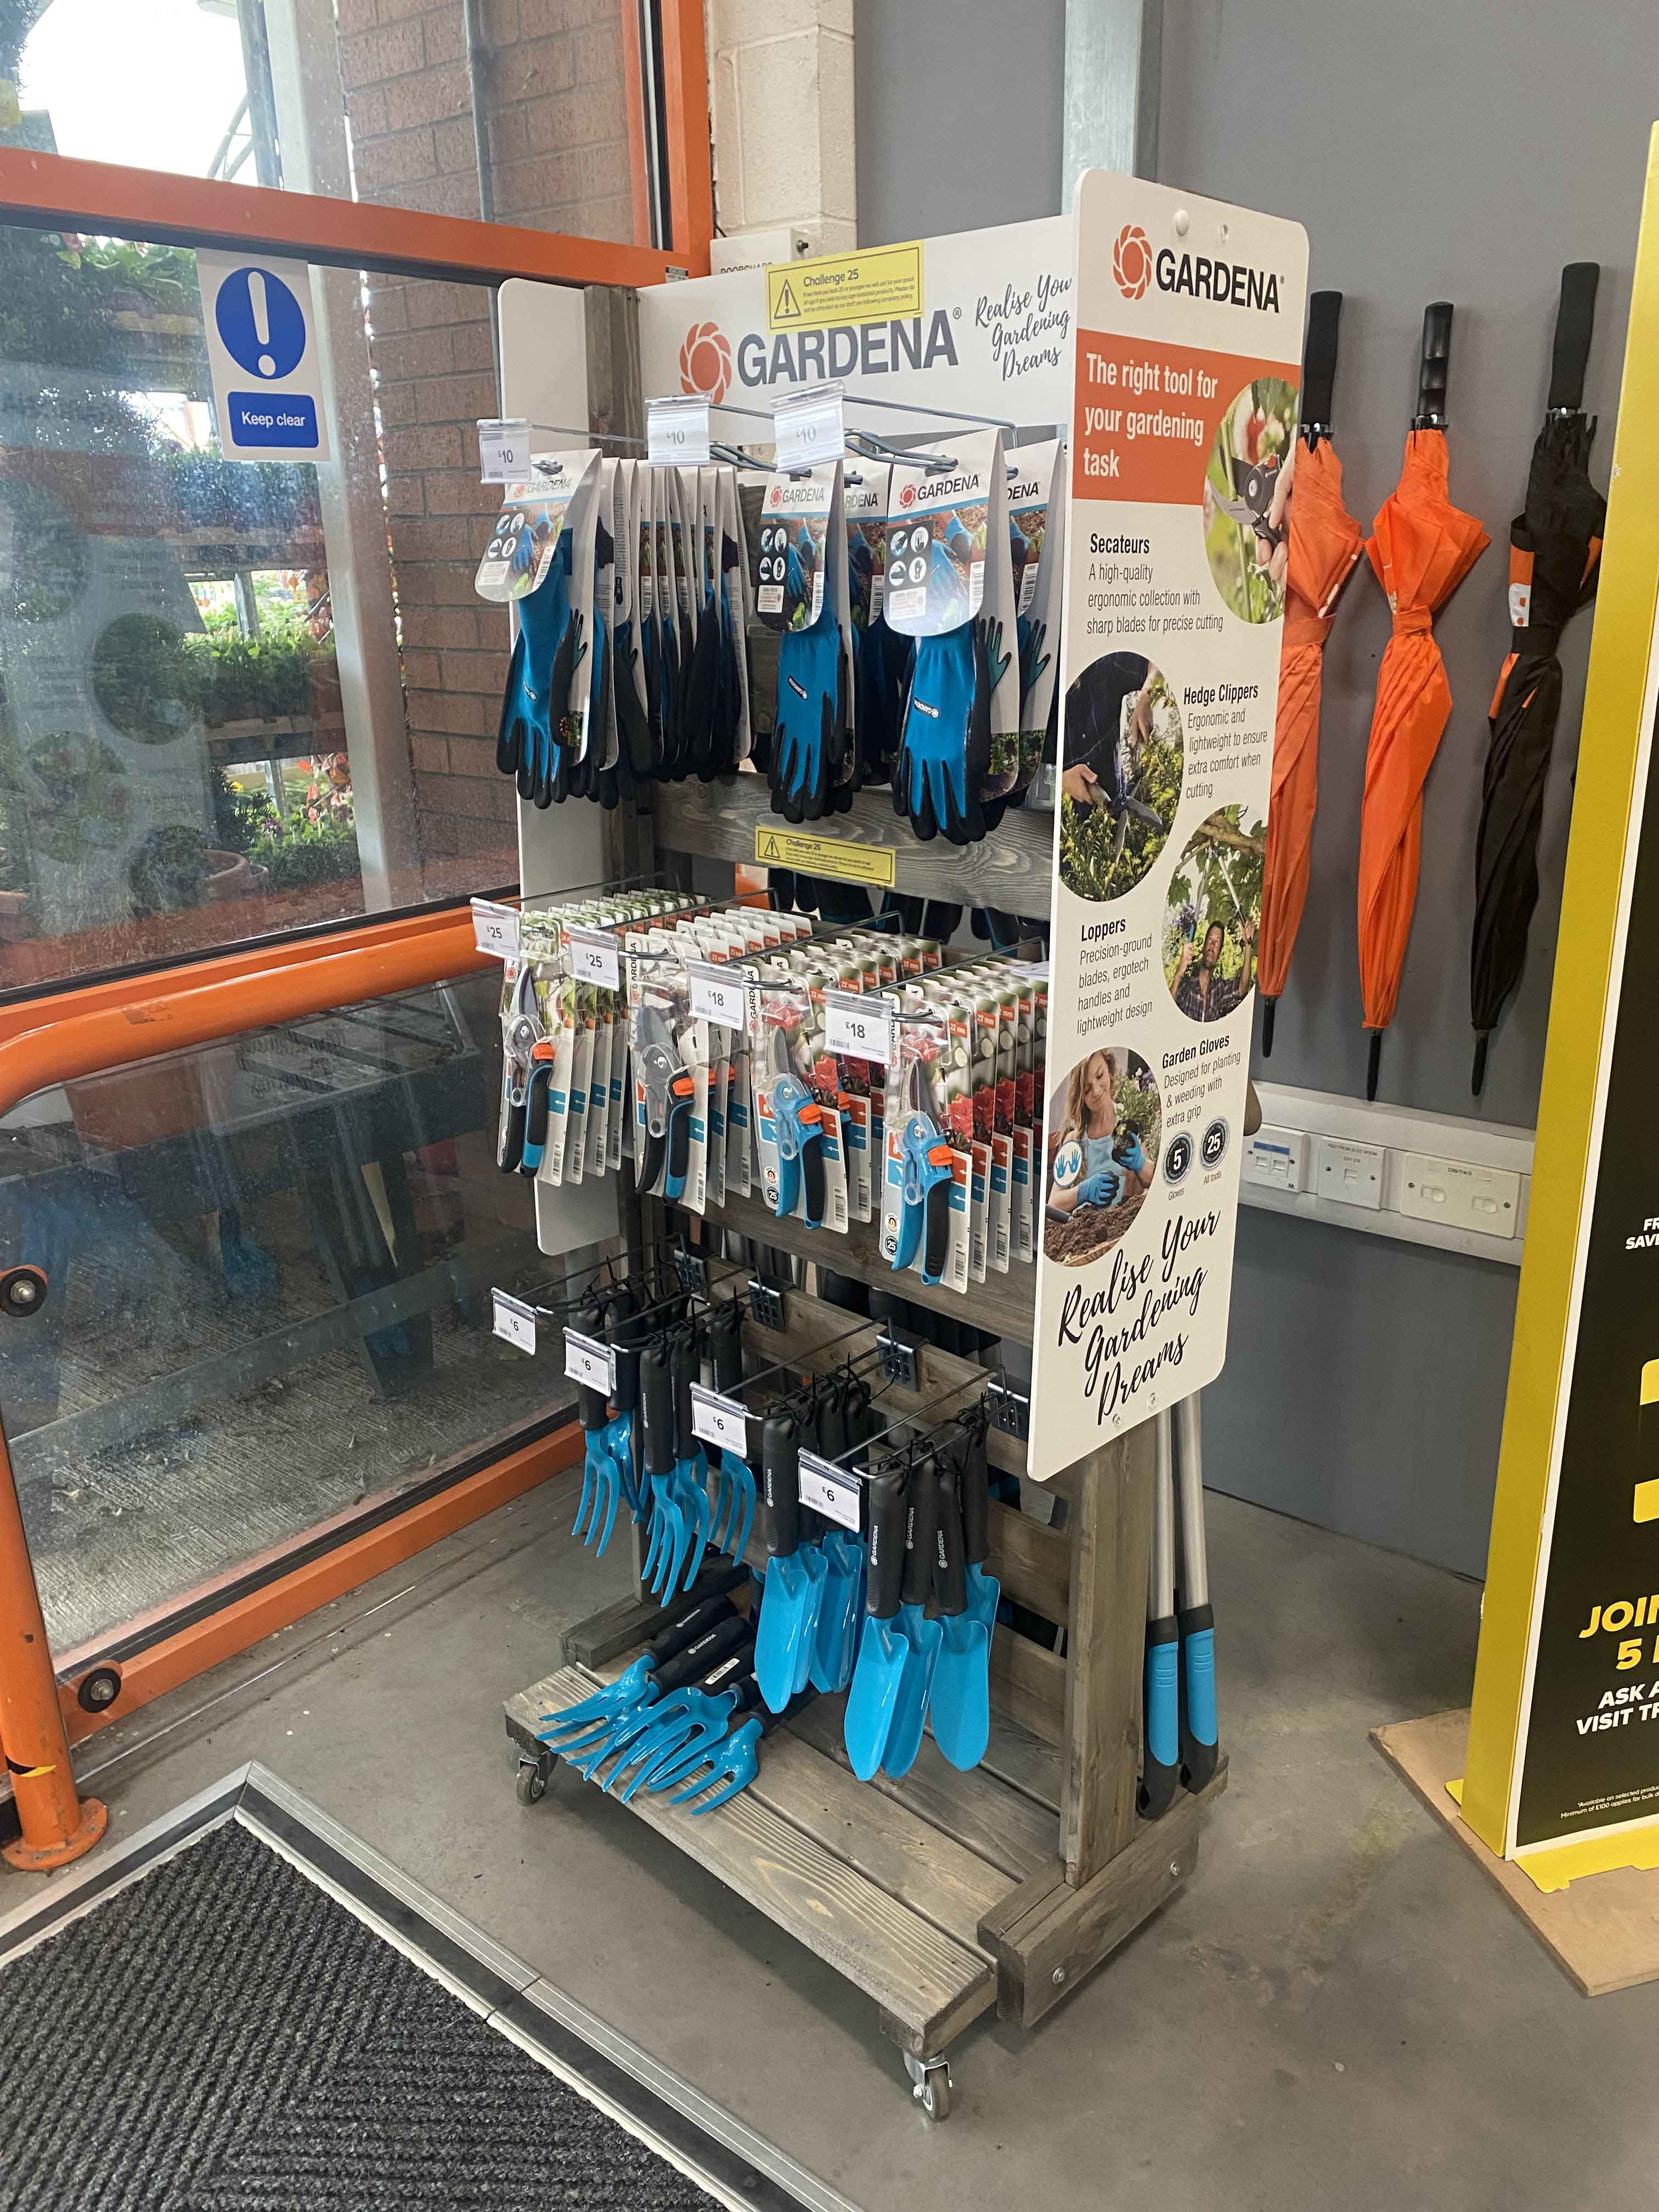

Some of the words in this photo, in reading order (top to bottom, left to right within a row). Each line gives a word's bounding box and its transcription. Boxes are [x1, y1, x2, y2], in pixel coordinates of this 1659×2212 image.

[804, 273, 845, 287] Challenge
[847, 268, 859, 280] 25
[1156, 248, 1279, 313] GARDENA
[976, 283, 1031, 328] Realise
[992, 307, 1070, 362] Gardening
[1002, 348, 1061, 381] Dreams
[1086, 353, 1117, 387] The
[1122, 360, 1159, 396] right
[1164, 369, 1192, 396] tool
[1197, 370, 1218, 399] for
[241, 411, 273, 428] Keep
[276, 414, 305, 426] clear
[1085, 405, 1122, 436] your
[1127, 405, 1204, 447] gardening
[498, 449, 513, 463] £10
[1084, 447, 1120, 478] task
[527, 478, 571, 493] GARDENA
[783, 488, 824, 503] GARDENA
[917, 473, 979, 500] GARDENA
[1090, 533, 1150, 554] Secateurs
[1088, 566, 1096, 580] A
[1099, 563, 1153, 584] high-quality
[1088, 590, 1137, 612] ergonomic
[1139, 590, 1180, 606] collection
[1183, 589, 1200, 606] with
[1087, 619, 1113, 636] sharp
[1116, 616, 1146, 633] blades
[1149, 615, 1160, 631] for
[1163, 615, 1193, 635] precise
[1195, 614, 1223, 632] cutting
[1184, 686, 1216, 707] Hedge
[1218, 683, 1259, 706] Clippers
[1187, 710, 1229, 731] Ergonomic
[1231, 707, 1245, 724] and
[1189, 731, 1232, 754] lightweight
[1233, 730, 1240, 745] to
[1242, 729, 1267, 744] ensure
[1188, 758, 1207, 775] extra
[1210, 754, 1240, 772] comfort
[1241, 752, 1261, 768] when
[1186, 782, 1214, 799] cutting
[786, 839, 812, 850] Challenge
[487, 926, 502, 939] £25
[1081, 916, 1126, 943] Loppers
[585, 953, 602, 968] £25
[1080, 933, 1152, 966] Precision-ground
[1079, 968, 1109, 989] blades,
[1113, 956, 1149, 982] ergotech
[708, 991, 724, 1006] £18
[1078, 988, 1111, 1012] handles
[1114, 983, 1130, 1001] and
[1076, 1008, 1123, 1035] lightweight
[1125, 999, 1153, 1022] design
[845, 1022, 865, 1039] £18
[1162, 1047, 1196, 1069] Garden
[1199, 1033, 1229, 1059] Gloves
[1164, 1066, 1199, 1090] Designed
[1200, 1060, 1211, 1076] for
[1212, 1050, 1241, 1075] planting
[1166, 1095, 1172, 1108] &
[1174, 1085, 1206, 1105] weeding
[1207, 1077, 1222, 1095] with
[1166, 1110, 1185, 1127] extra
[1187, 1104, 1201, 1122] grip
[1207, 1132, 1221, 1154] 25
[1211, 1171, 1222, 1182] tools
[769, 1190, 777, 1200] 25
[1168, 1188, 1184, 1201] Gloves
[888, 1240, 896, 1251] 25
[1058, 1249, 1154, 1347] Realise
[1162, 1210, 1221, 1282] Your
[510, 1318, 519, 1331] £6
[1085, 1267, 1208, 1397] Gardening
[582, 1357, 591, 1370] £6
[1097, 1333, 1189, 1426] Dreams
[713, 1417, 724, 1430] £6
[822, 1487, 835, 1502] £6
[937, 1530, 945, 1559] GARDENA
[1616, 1638, 1642, 1670] 5
[1598, 1683, 1645, 1710] ASK
[1576, 1707, 1634, 1736] VISIT
[1615, 1790, 1639, 1800] selected
[1560, 1808, 1588, 1819] Minimum
[1595, 1802, 1610, 1810] £100
[1611, 1798, 1632, 1808] applies
